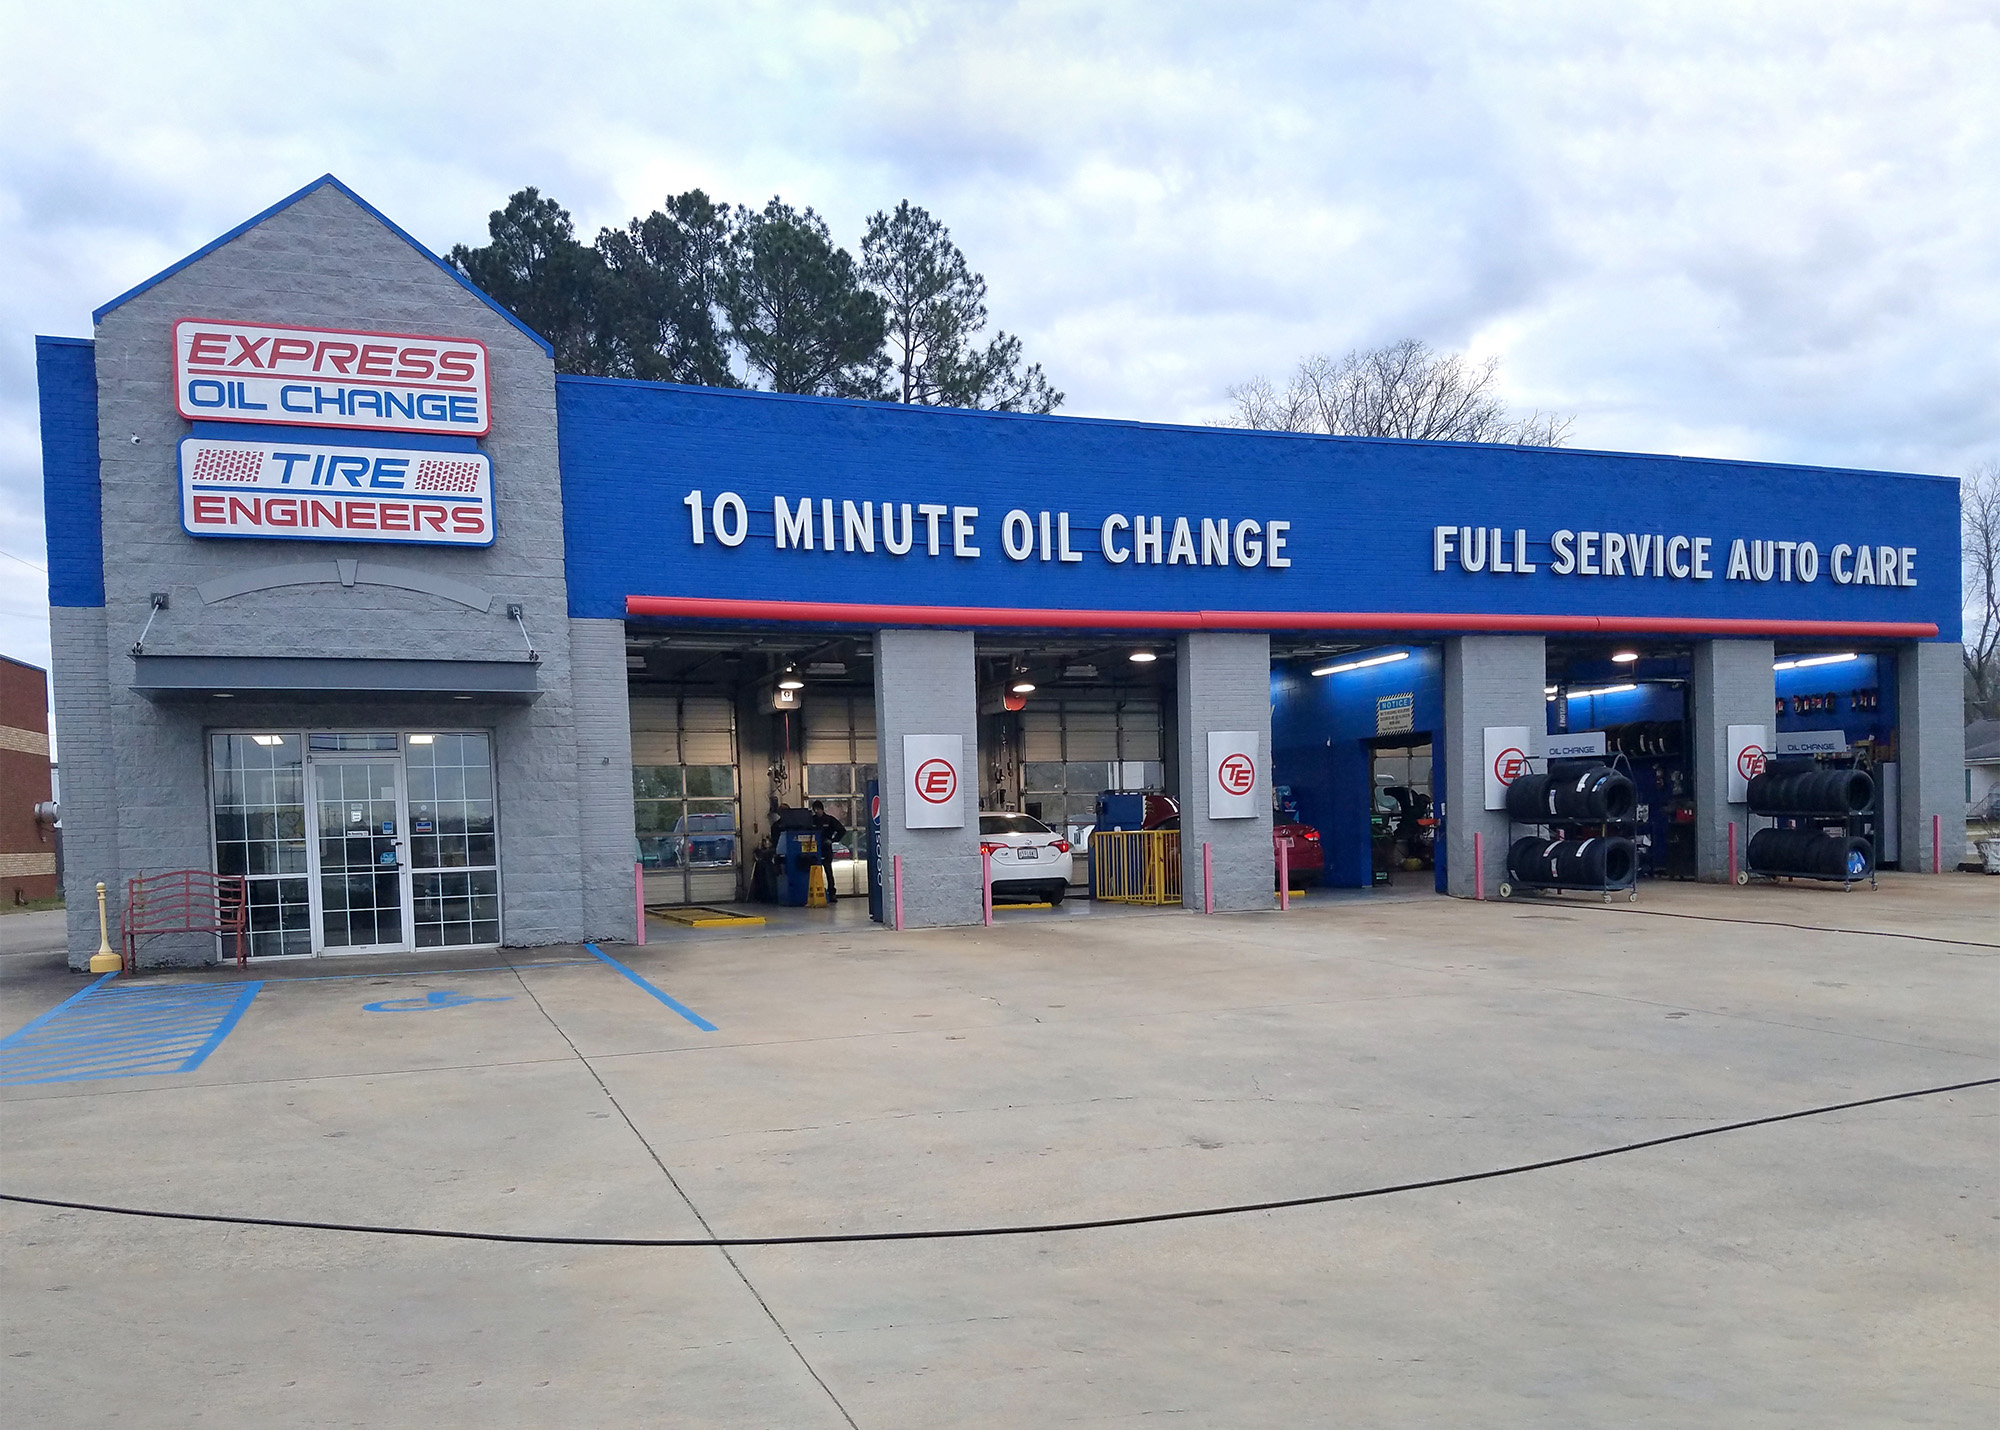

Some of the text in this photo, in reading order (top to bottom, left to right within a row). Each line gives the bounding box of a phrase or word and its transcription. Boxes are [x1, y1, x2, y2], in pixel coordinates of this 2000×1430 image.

[187, 332, 478, 382] EXPRESS
[188, 379, 479, 424] OIL CHANGE
[271, 452, 410, 489] TIRE
[193, 496, 485, 534] ENGINEERS
[684, 489, 1292, 568] 10 MINUTE OIL CHANGE
[1433, 525, 1918, 587] FULL SERVICE AUTO CARE
[1382, 699, 1408, 709] NOTICE
[1562, 745, 1595, 754] CHANGE
[1800, 743, 1835, 751] CHANGE
[925, 771, 950, 793] E
[1225, 763, 1251, 787] TE
